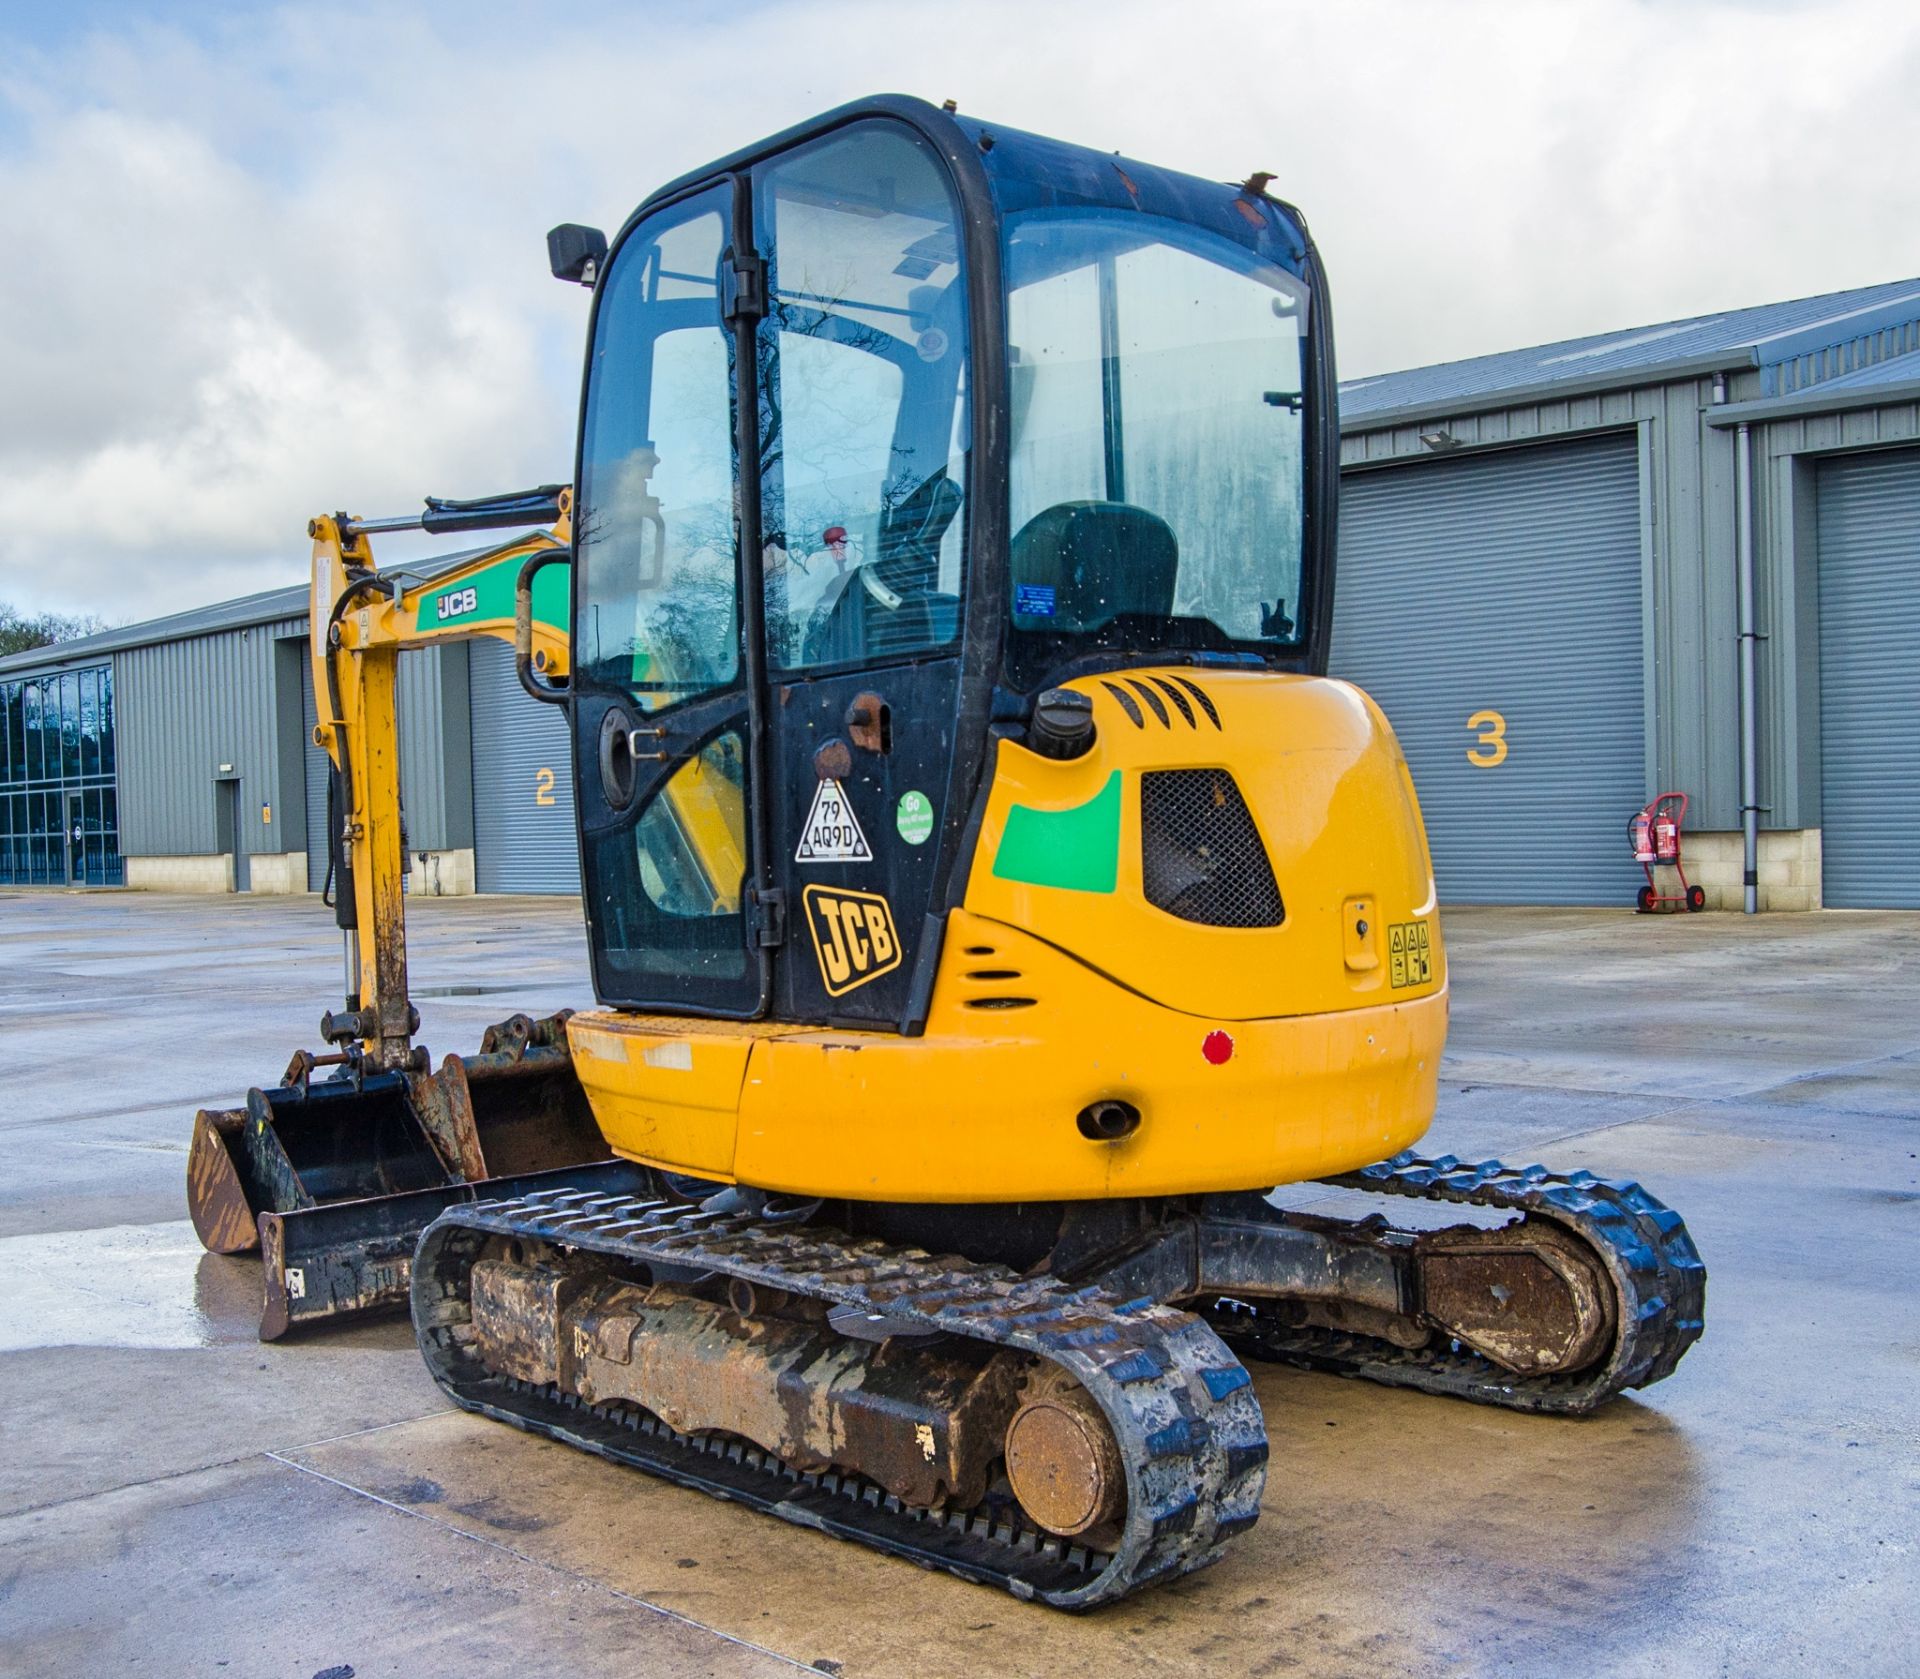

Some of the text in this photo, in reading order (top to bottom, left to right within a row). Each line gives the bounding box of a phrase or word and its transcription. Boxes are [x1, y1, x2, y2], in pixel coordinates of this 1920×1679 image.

[438, 588, 477, 619] JCB
[1467, 710, 1508, 768] 3
[536, 768, 556, 806] 2
[822, 801, 840, 823] 79
[906, 795, 920, 812] Go
[813, 825, 853, 848] AQ9D
[817, 897, 893, 983] JCB
